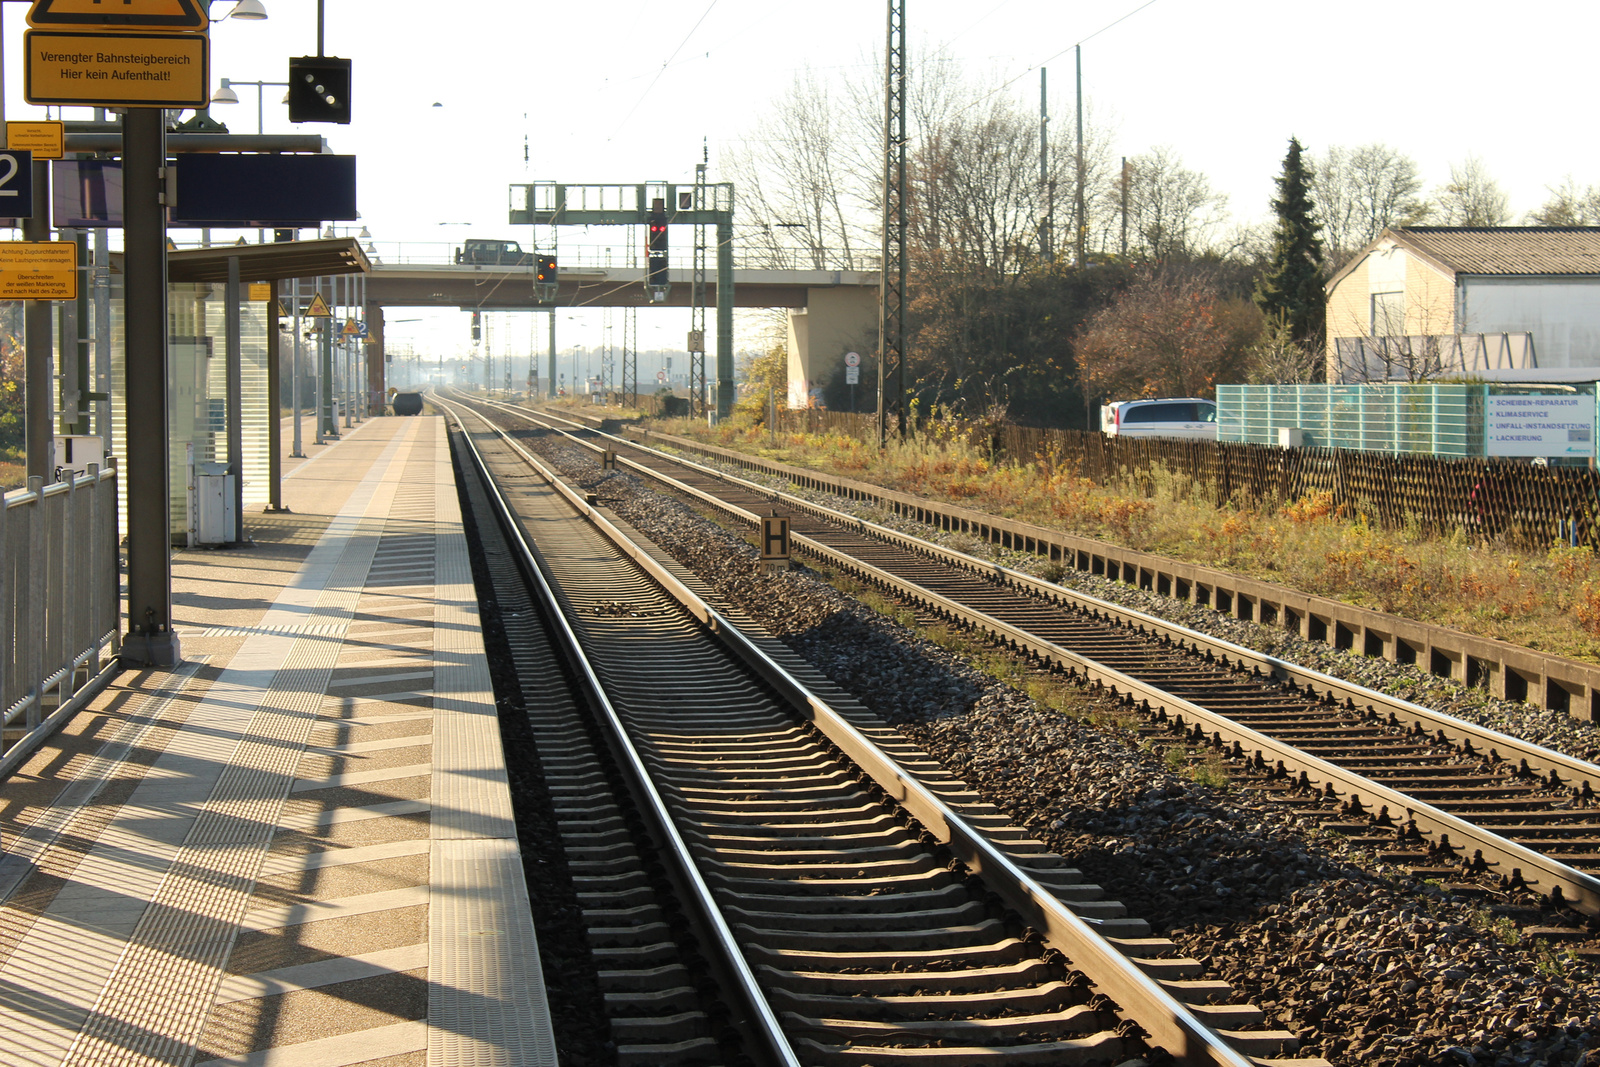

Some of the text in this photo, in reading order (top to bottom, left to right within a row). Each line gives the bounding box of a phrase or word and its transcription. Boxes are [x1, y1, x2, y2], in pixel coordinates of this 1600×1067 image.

[40, 51, 190, 66] Verengter Bahnsteigbereich
[60, 69, 171, 81] Hier kein Aufenthalt!
[0, 153, 19, 197] 2
[358, 323, 367, 335] 2
[604, 453, 615, 469] H
[765, 520, 787, 555] H
[765, 563, 775, 571] 70
